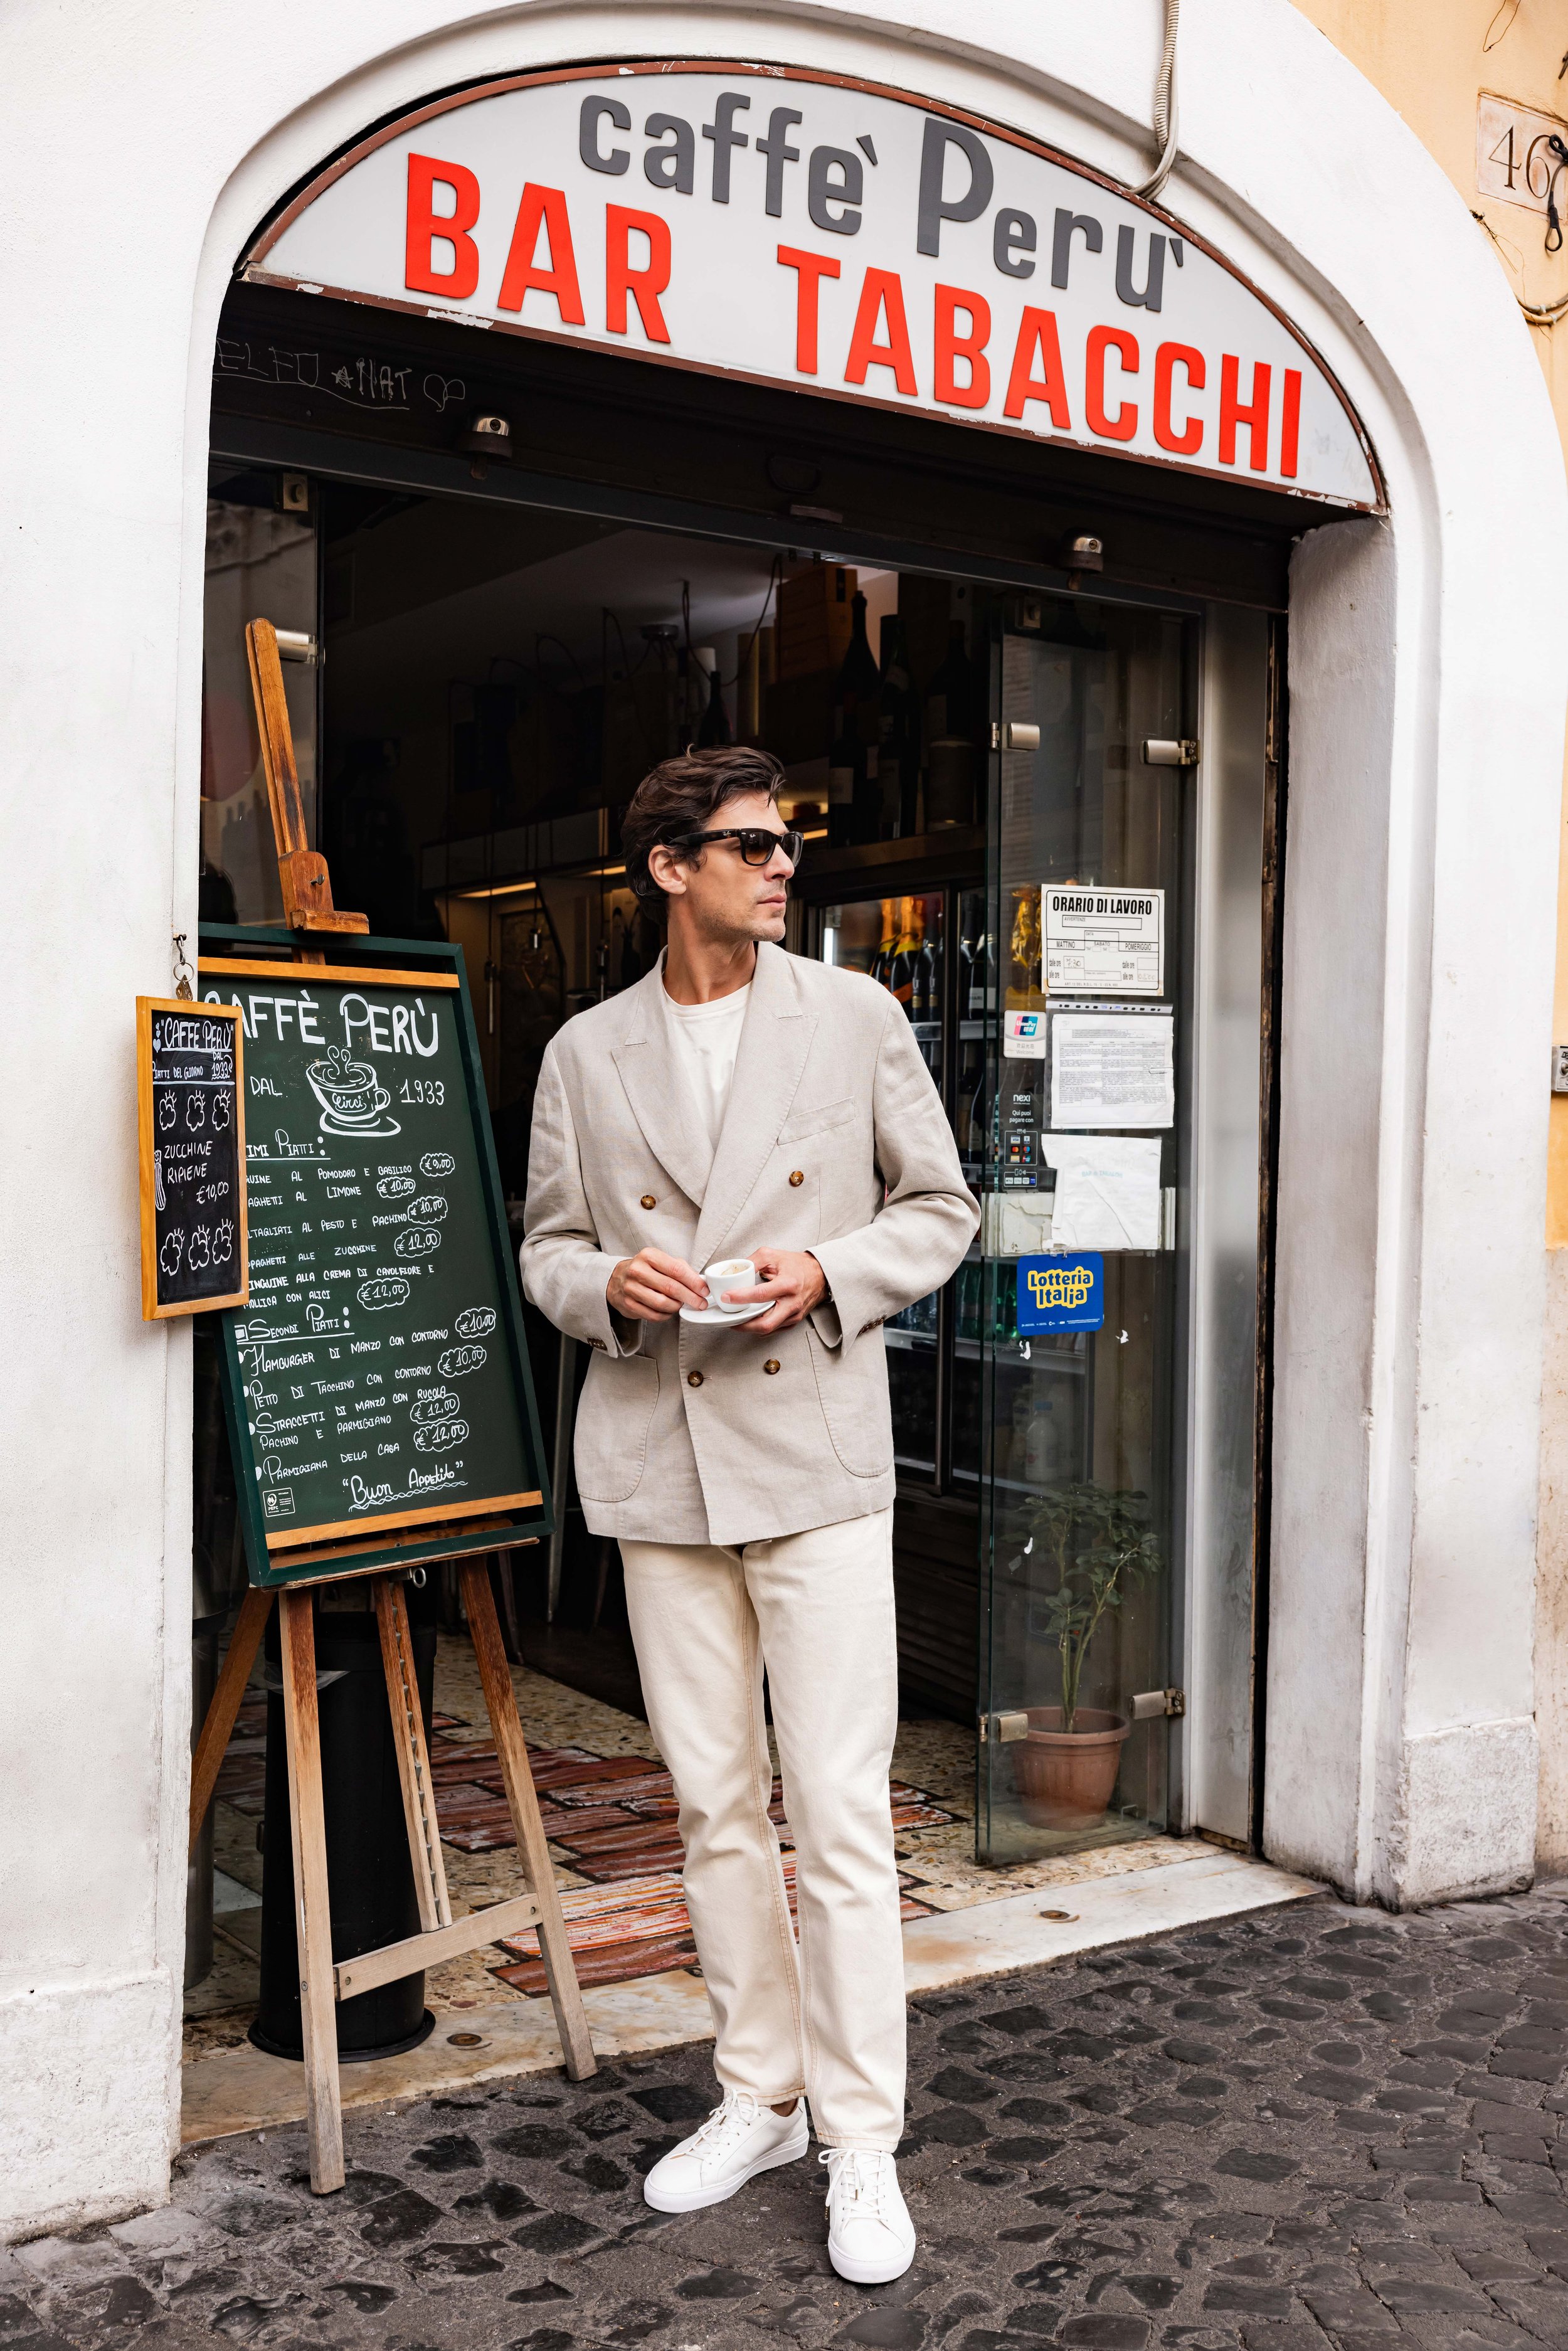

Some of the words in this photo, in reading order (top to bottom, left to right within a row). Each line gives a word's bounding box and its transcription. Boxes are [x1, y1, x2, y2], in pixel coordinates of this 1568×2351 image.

[1488, 125, 1551, 198] 46
[405, 153, 671, 342] BAR
[778, 245, 1301, 477] TABACCHI
[1053, 896, 1094, 913] ORARIO
[1096, 898, 1107, 913] DI
[1111, 899, 1152, 915] LAVORO
[339, 994, 438, 1058] PERÙ
[213, 1052, 223, 1061] DAL
[173, 1066, 183, 1078] DEL
[184, 1066, 204, 1080] GIORNO
[211, 1062, 228, 1077] 1933
[250, 1076, 282, 1096] DAL
[400, 1079, 444, 1105] 1933
[164, 1141, 213, 1159] ZUCCHINE
[246, 1145, 270, 1159] IMI
[168, 1163, 207, 1184] RIPIENE
[292, 1171, 302, 1181] AL
[318, 1169, 356, 1179] POMODORO
[378, 1165, 411, 1175] BASILICO
[248, 1196, 283, 1207] AGHETTI
[296, 1192, 307, 1201] AL
[327, 1187, 361, 1198] LIMONE
[248, 1226, 292, 1239] LTAGLIATI
[302, 1223, 312, 1233] AL
[321, 1220, 344, 1231] PESTO
[352, 1219, 357, 1228] E
[373, 1213, 408, 1226] PACHINO
[299, 1253, 315, 1261] ALLE
[249, 1276, 289, 1291] INGUINE
[297, 1272, 315, 1283] ALLA
[324, 1270, 351, 1280] CREMA
[357, 1268, 368, 1276] DI
[377, 1266, 421, 1277] CAVOLFIORE
[1030, 1270, 1091, 1287] Lotteria
[243, 1296, 277, 1309] OLLICA
[286, 1293, 302, 1302] CON
[309, 1290, 330, 1299] ALICI
[1039, 1287, 1084, 1305] Italia
[247, 1319, 300, 1340] SECONDI
[243, 1344, 314, 1376] HAMBURGER
[329, 1348, 340, 1359] DI
[351, 1341, 381, 1354] MANZO
[389, 1336, 404, 1345] CON
[411, 1329, 448, 1342] CONTORNO
[248, 1380, 277, 1409] PETTO
[291, 1386, 304, 1399] DI
[310, 1380, 354, 1394] TACCHINO
[367, 1374, 382, 1384] CON
[395, 1366, 431, 1379] CONTORNO
[255, 1411, 325, 1435] STRACCETTI
[335, 1406, 346, 1416] DI
[355, 1397, 385, 1411] MANZO
[393, 1393, 408, 1403] CON
[418, 1386, 447, 1400] RUCOLA
[260, 1435, 298, 1450] PACHINO
[316, 1430, 323, 1439] E
[337, 1414, 391, 1434] PARMIGIANO
[263, 1456, 327, 1483] PARMIGIANA
[341, 1451, 367, 1462] DELLA
[378, 1443, 399, 1455] CASA
